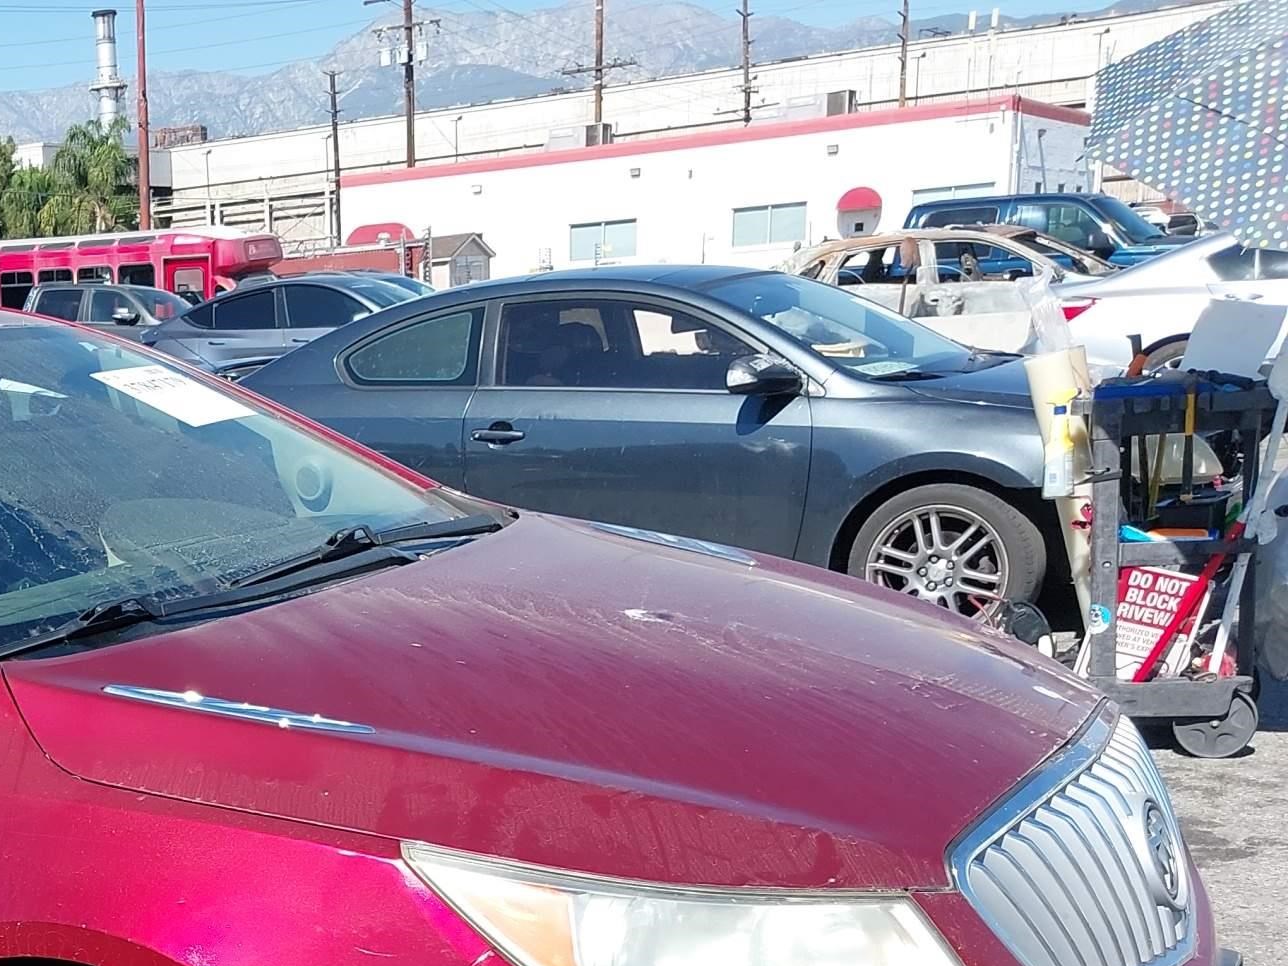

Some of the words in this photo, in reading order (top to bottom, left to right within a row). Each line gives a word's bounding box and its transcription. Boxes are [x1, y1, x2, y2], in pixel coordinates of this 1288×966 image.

[1128, 570, 1153, 589] DO
[1155, 576, 1191, 597] NOT
[1125, 587, 1182, 612] BLOCK
[1116, 601, 1175, 627] RIVEW
[1117, 624, 1150, 637] THORIZED
